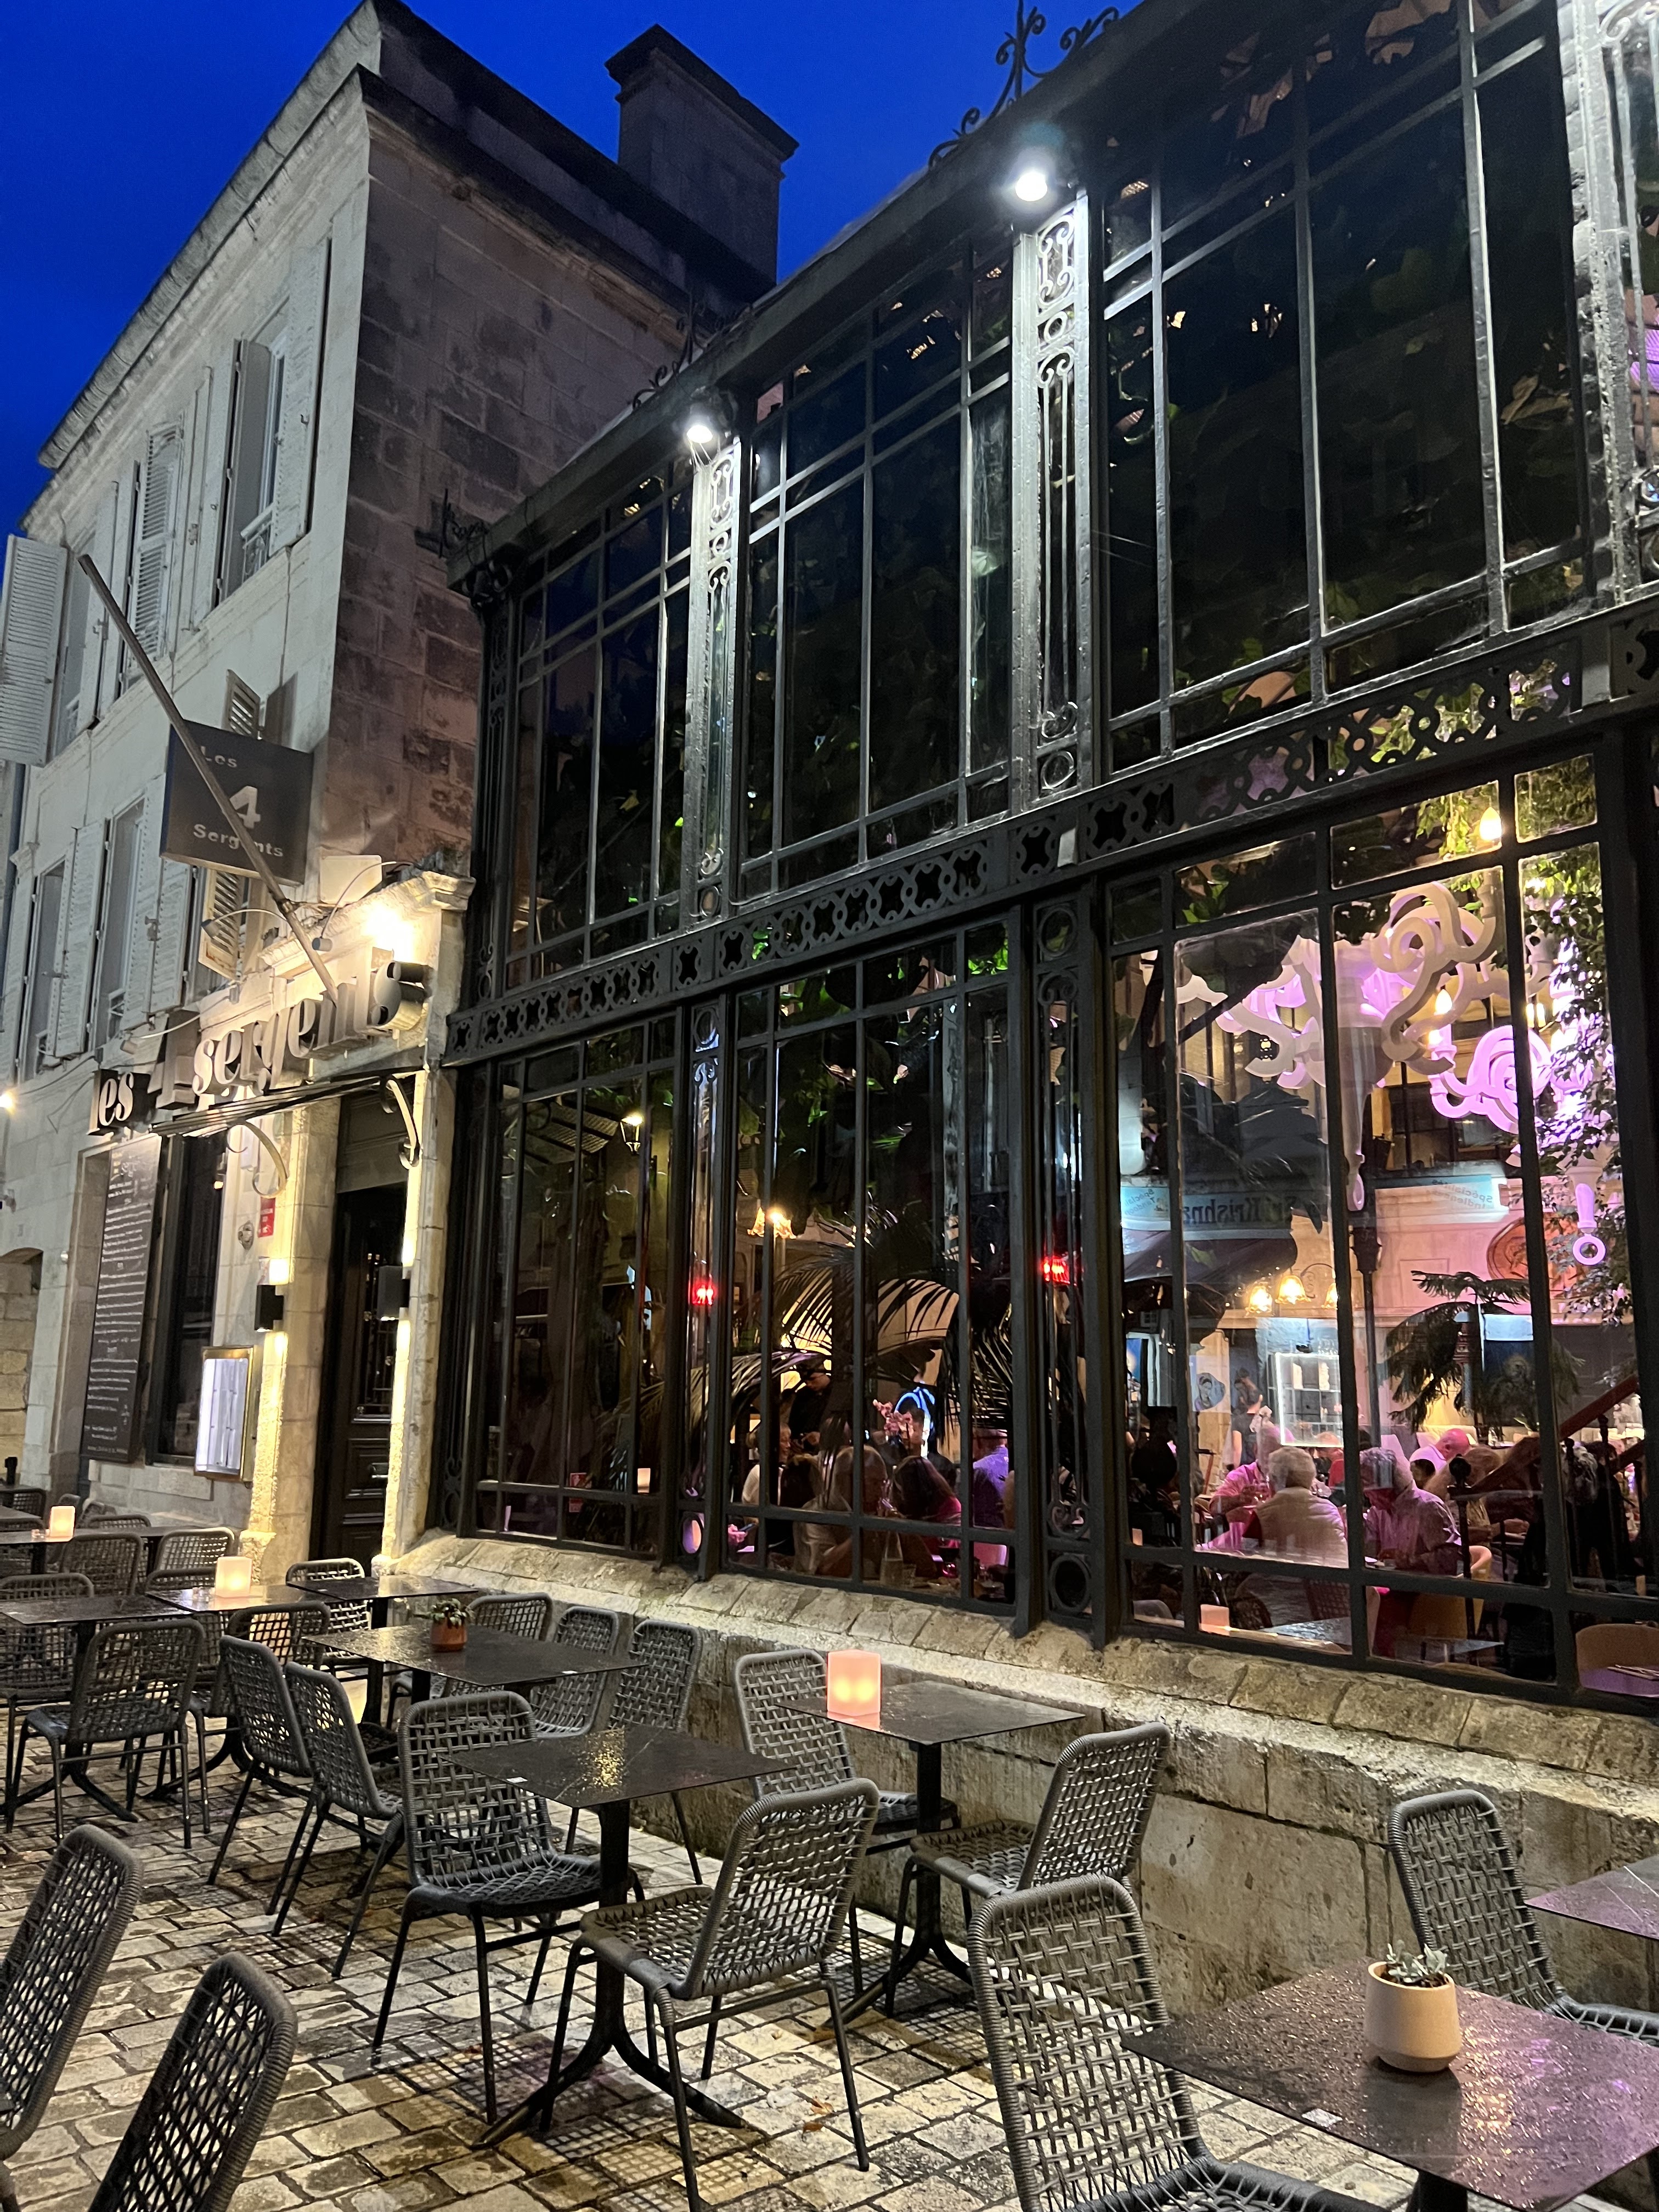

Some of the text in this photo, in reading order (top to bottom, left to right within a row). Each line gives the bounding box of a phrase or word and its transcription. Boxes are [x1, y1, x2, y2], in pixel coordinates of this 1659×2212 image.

[200, 746, 238, 768] Les
[229, 785, 261, 830] 4
[193, 823, 284, 857] Sergnts
[86, 1069, 134, 1136] les
